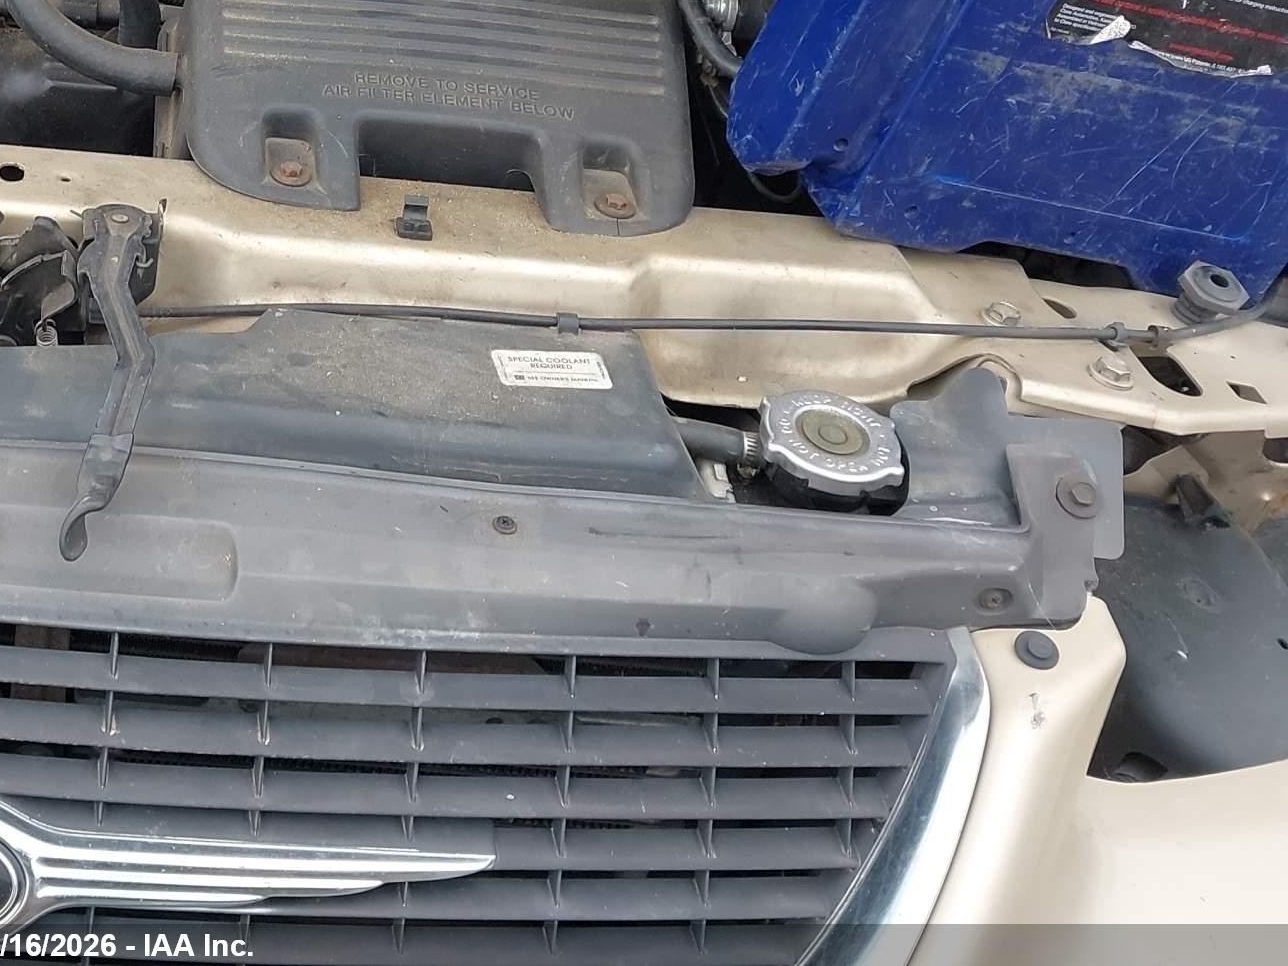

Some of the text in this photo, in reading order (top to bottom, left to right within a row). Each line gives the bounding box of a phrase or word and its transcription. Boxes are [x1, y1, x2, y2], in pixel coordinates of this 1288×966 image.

[354, 72, 539, 101] REMOVE TO SERVICE
[322, 84, 575, 121] AIR FILTER ELEMENT BELOW
[530, 362, 573, 370] REQUIRED
[546, 356, 591, 364] COOLANT
